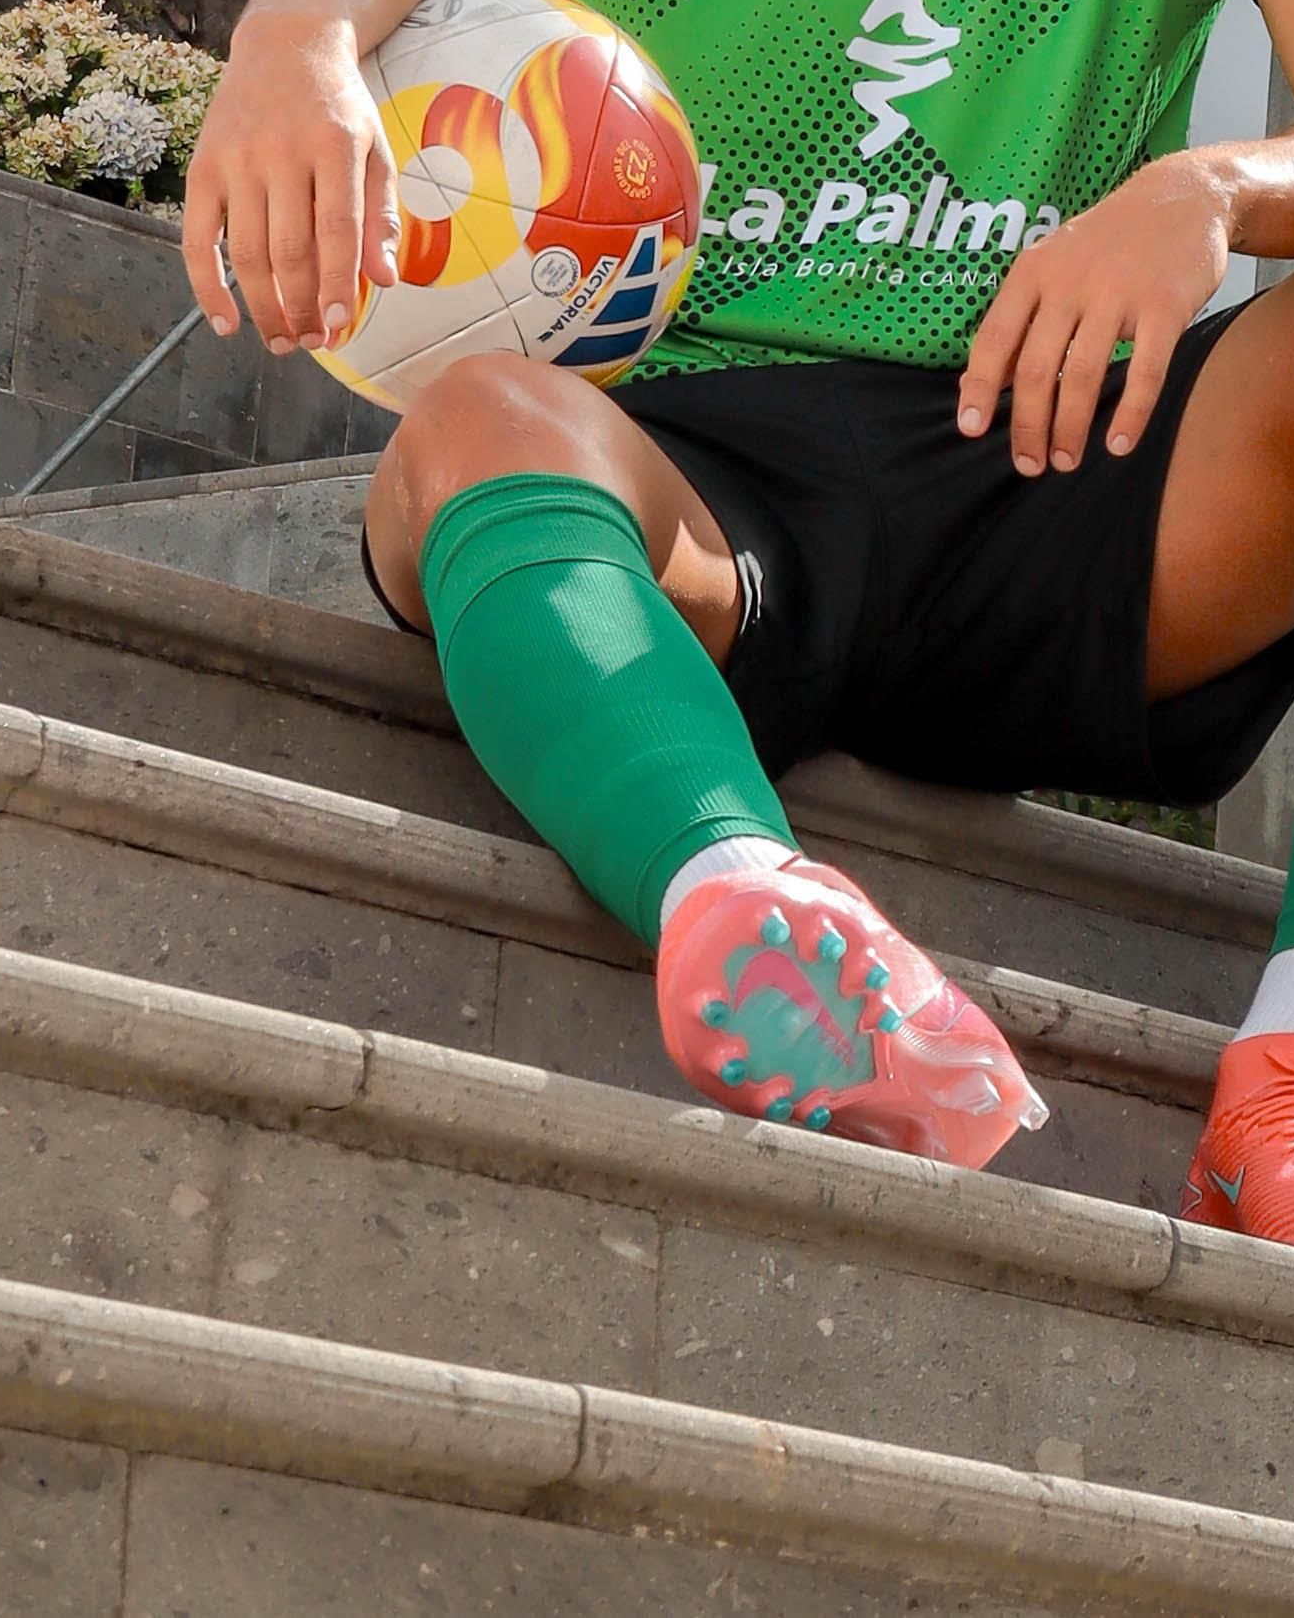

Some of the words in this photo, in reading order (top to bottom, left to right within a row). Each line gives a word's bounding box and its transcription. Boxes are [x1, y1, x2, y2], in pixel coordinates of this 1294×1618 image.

[799, 174, 1060, 252] Palma
[552, 259, 614, 332] VICTORIA
[721, 255, 778, 278] Isla
[795, 256, 906, 286] Bonita
